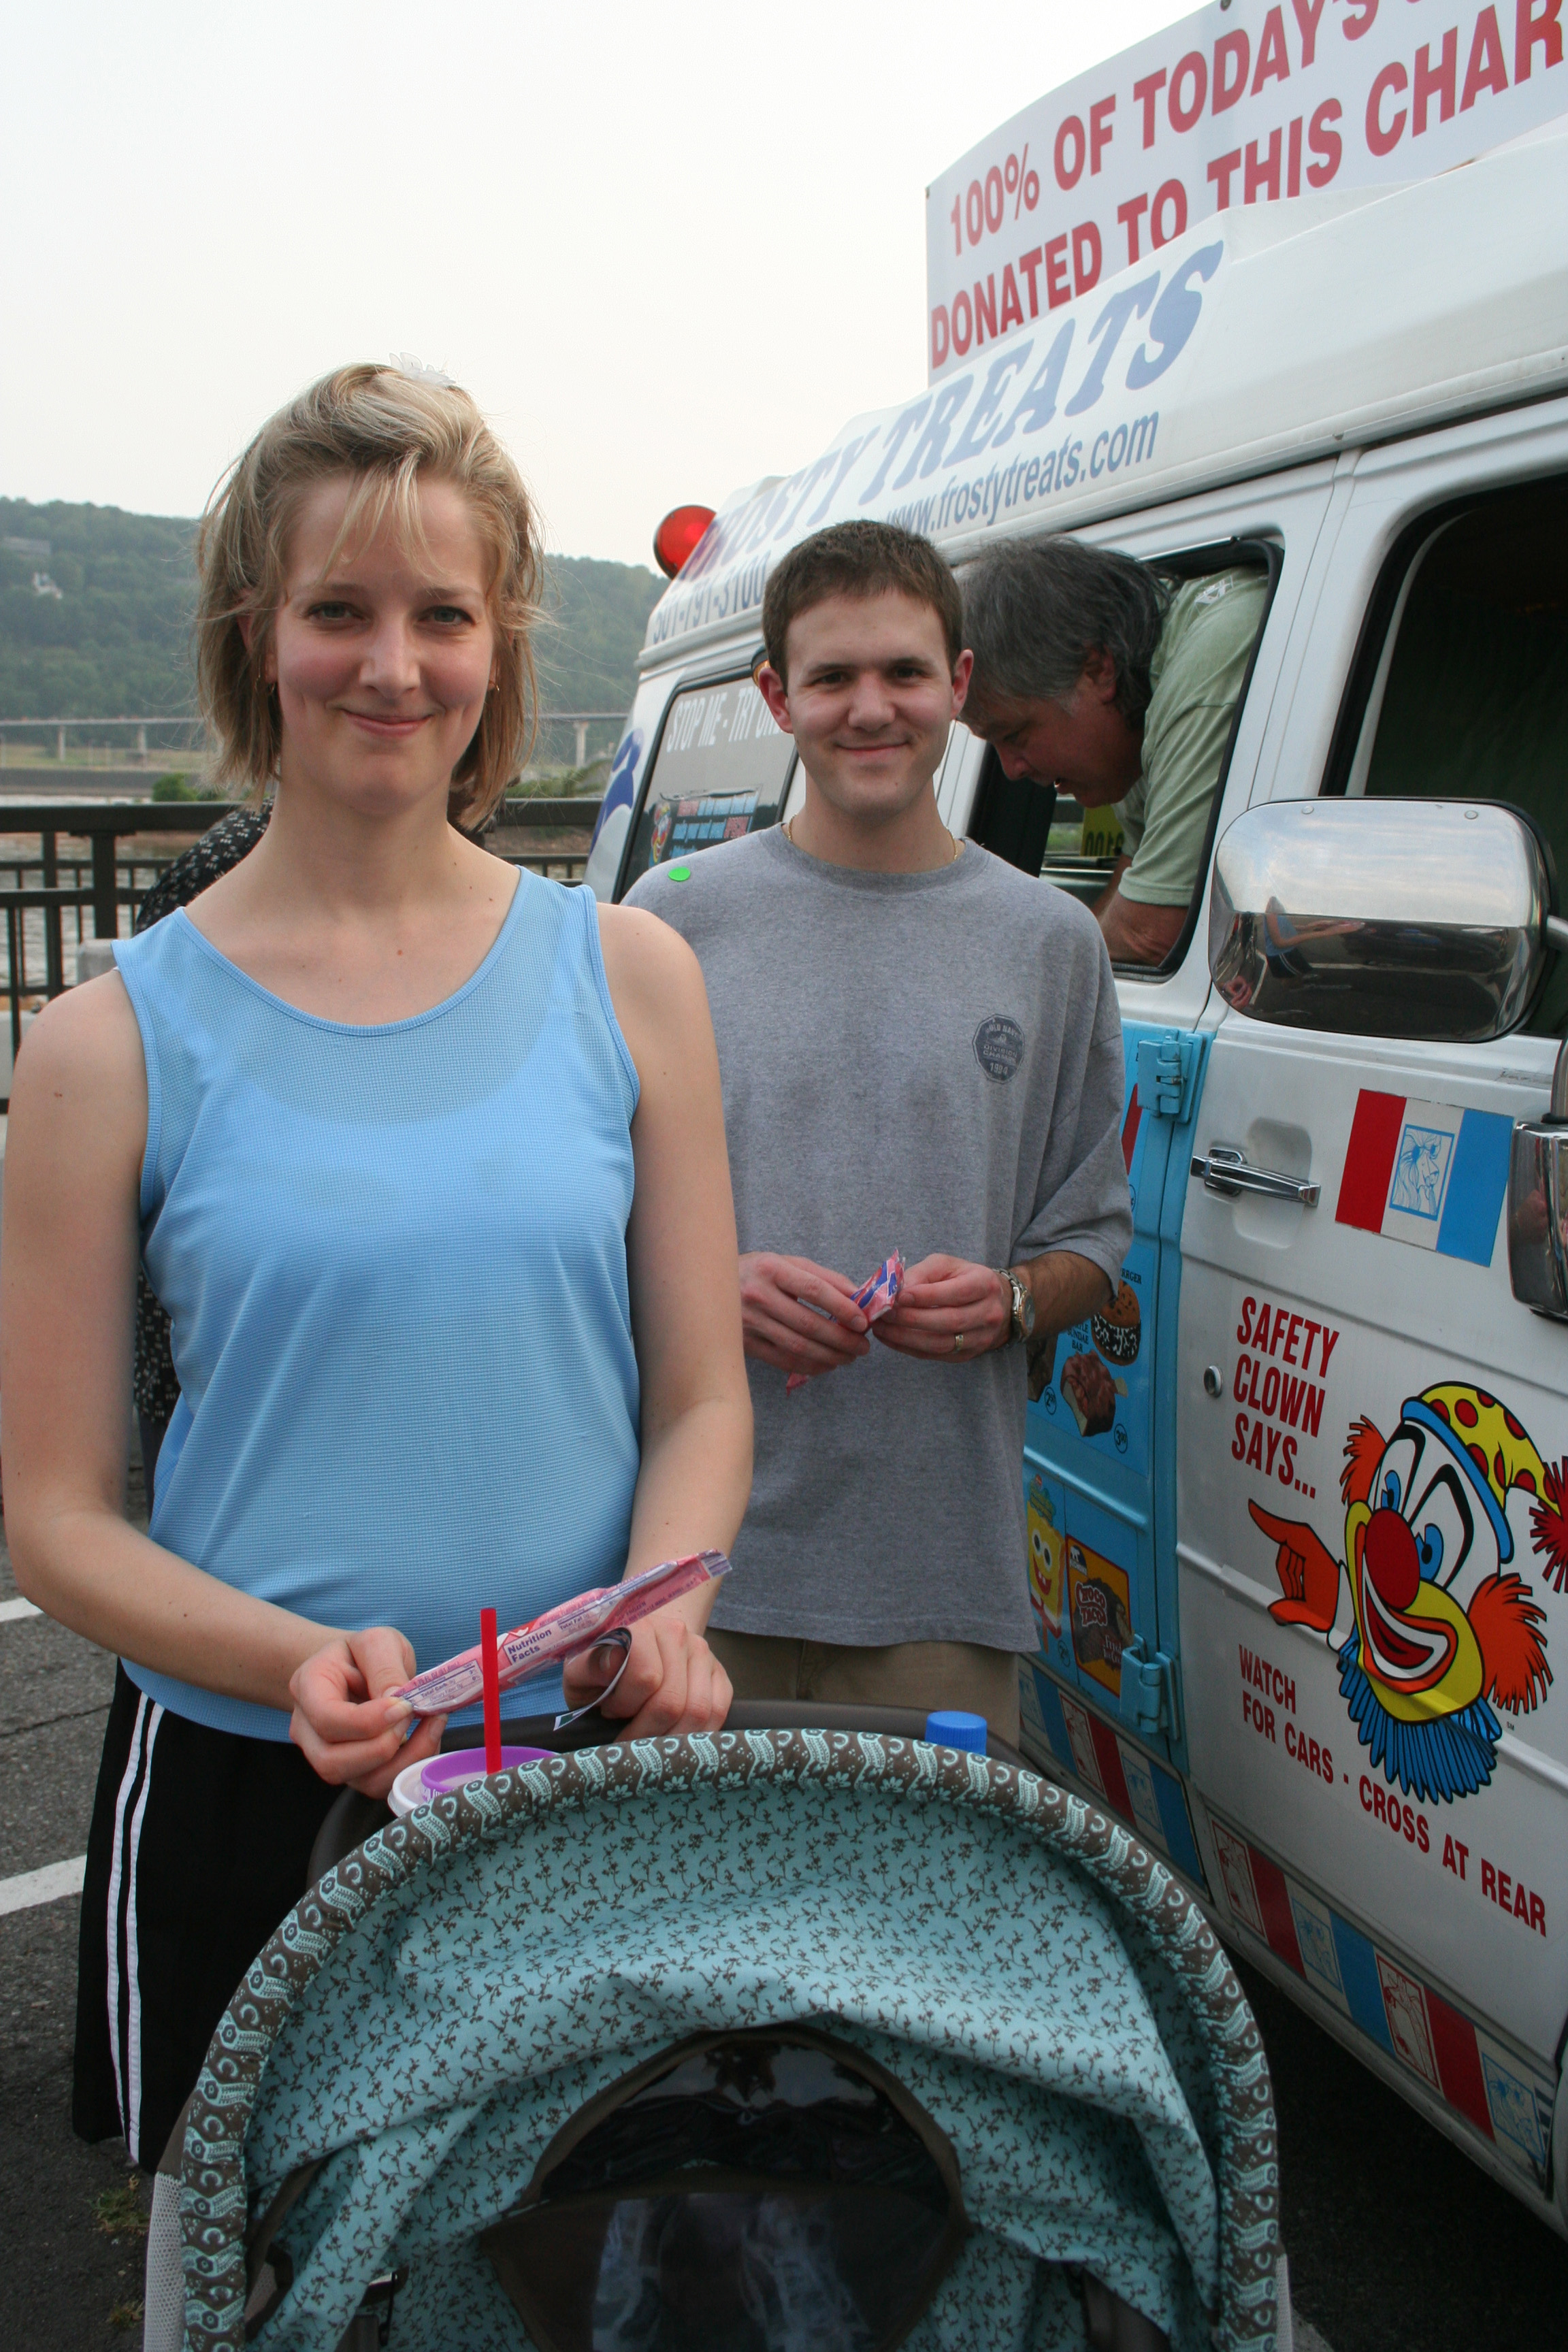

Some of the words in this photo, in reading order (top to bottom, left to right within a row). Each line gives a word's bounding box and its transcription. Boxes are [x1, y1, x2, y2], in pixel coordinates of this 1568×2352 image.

[930, 220, 1102, 370] DONATED
[1117, 178, 1188, 266] TO
[1207, 97, 1342, 210] THIS
[1365, 0, 1564, 157] CHAR
[950, 142, 1040, 257] 100%
[1054, 94, 1117, 191] OF
[679, 424, 881, 582] FROSTY
[858, 240, 1224, 507] TREATS
[886, 411, 1159, 534] www.frostytreats.com
[666, 697, 706, 753] STOP
[698, 692, 728, 747] ME
[728, 686, 762, 742] TRY
[990, 1062, 1009, 1076] 1994
[1067, 1327, 1089, 1345] SUNDAE
[1072, 1340, 1083, 1353] BAR
[1237, 1296, 1340, 1378] SAFETY
[1233, 1354, 1326, 1438] CLOWN
[1231, 1412, 1316, 1499] SAYS...
[1075, 1581, 1107, 1608] CHOCO
[1080, 1605, 1108, 1627] TACO
[508, 1629, 552, 1654] Nutrition
[511, 1646, 540, 1663] Facts
[1238, 1644, 1296, 1714] WATCH
[1243, 1690, 1276, 1744] FOR
[1284, 1721, 1333, 1784] CARS
[1359, 1775, 1430, 1854] CROSS
[1442, 1833, 1469, 1880] AT
[1480, 1857, 1546, 1938] REAR
